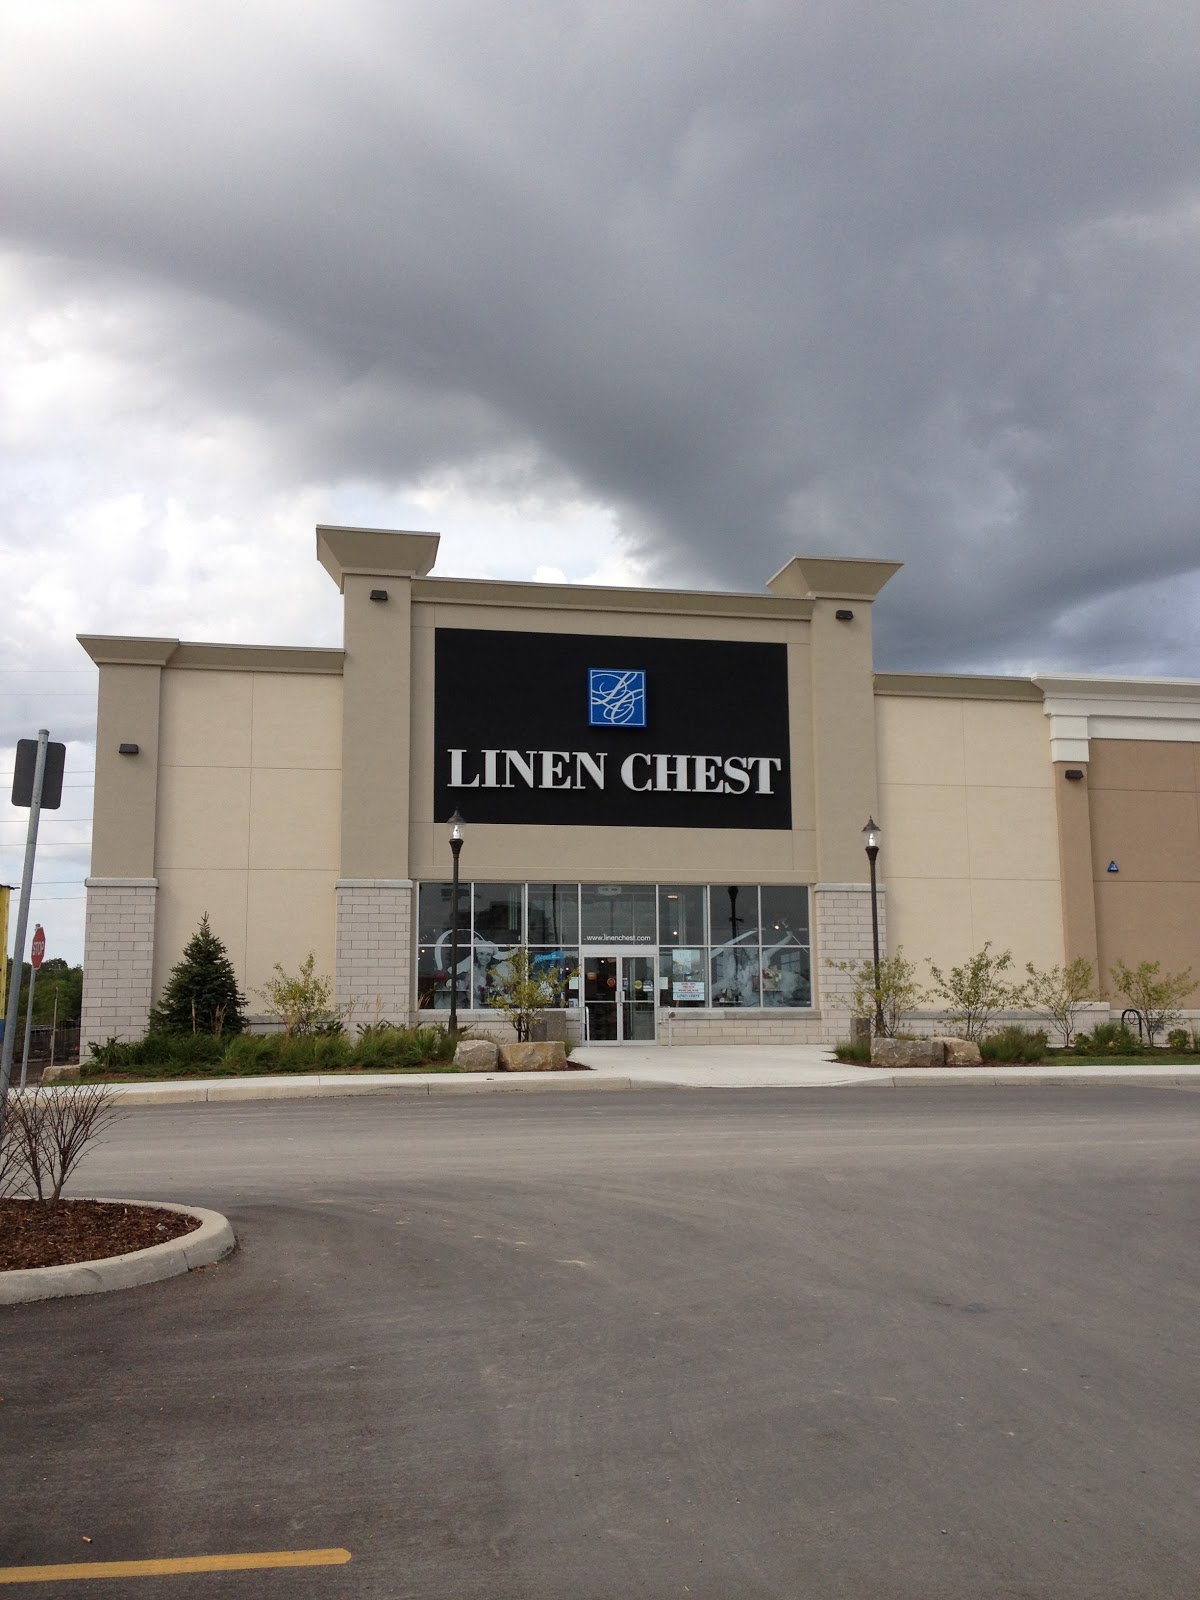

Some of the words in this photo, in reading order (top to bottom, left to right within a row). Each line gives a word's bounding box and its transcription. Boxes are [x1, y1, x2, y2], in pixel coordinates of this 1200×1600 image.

[447, 749, 608, 790] LINEN
[620, 752, 782, 795] CHEST
[586, 933, 651, 941] www.linenchest.com
[32, 941, 45, 956] STOP
